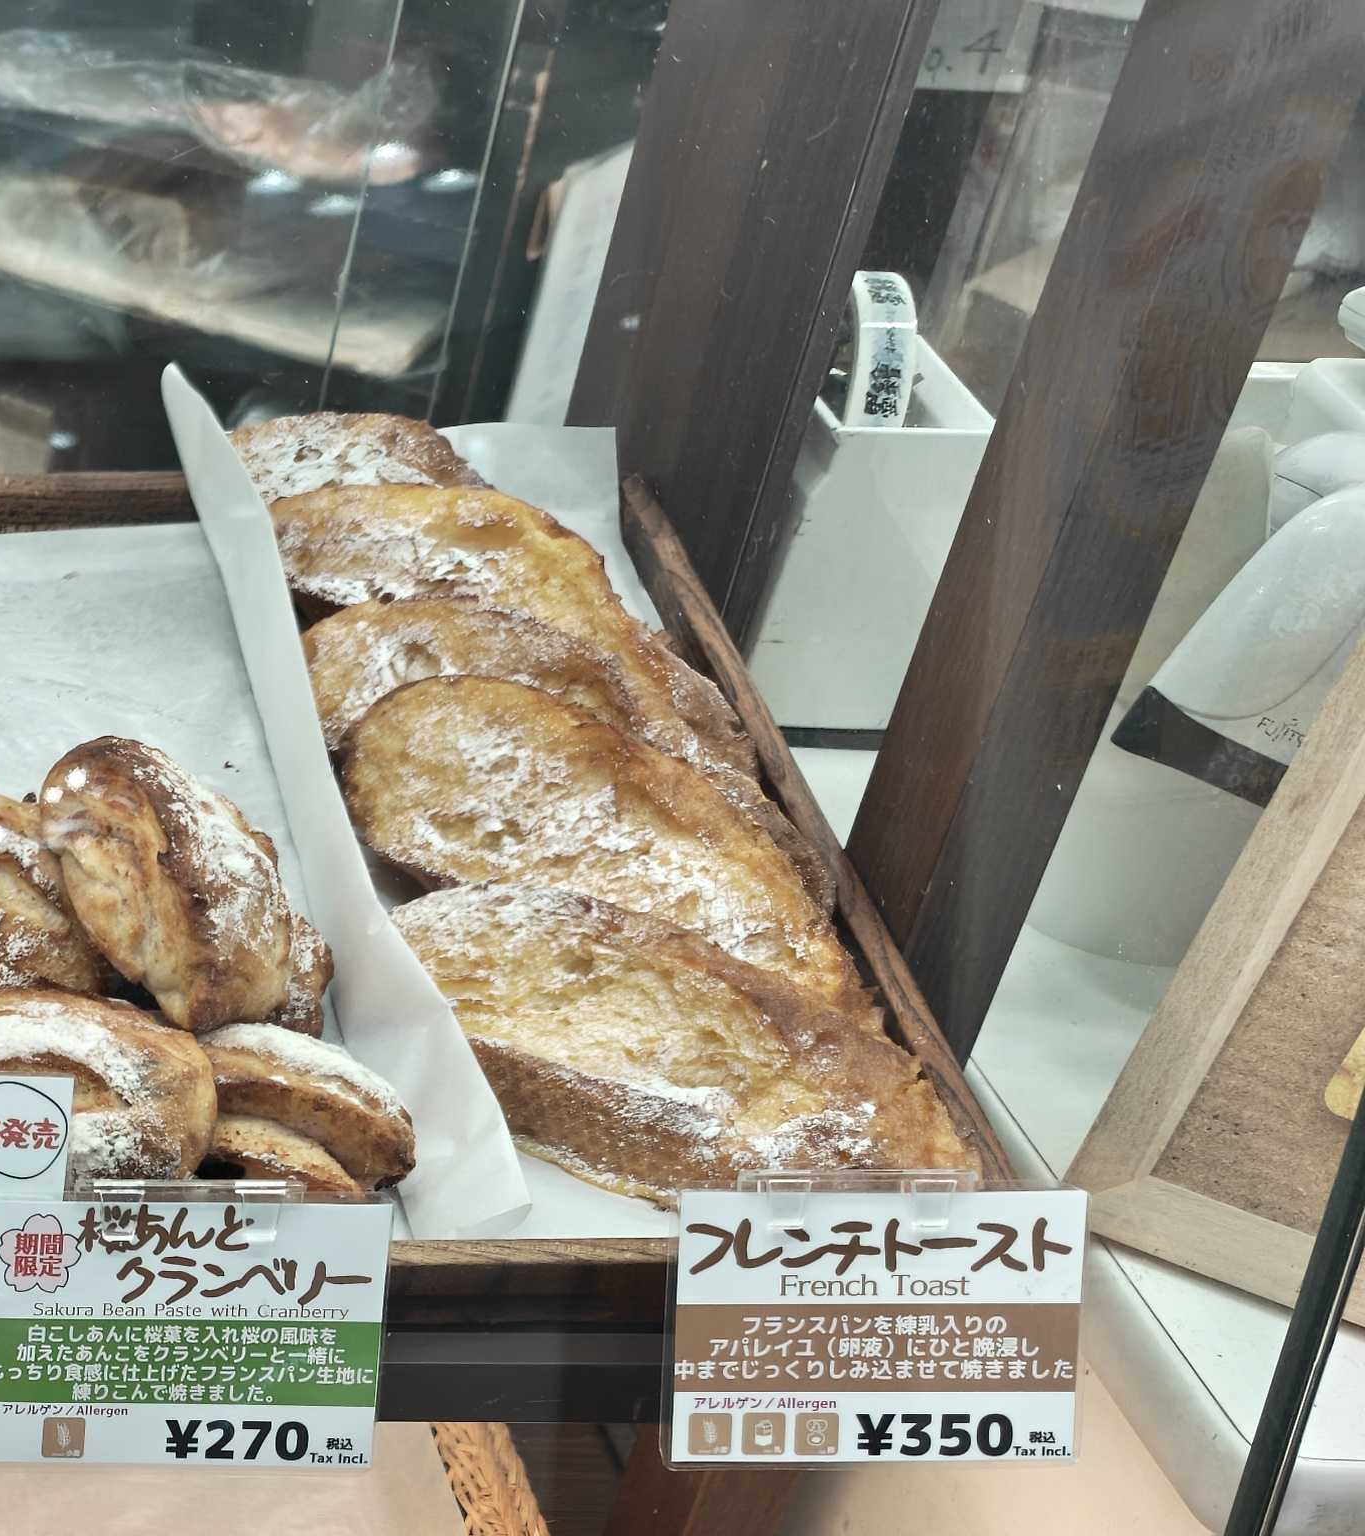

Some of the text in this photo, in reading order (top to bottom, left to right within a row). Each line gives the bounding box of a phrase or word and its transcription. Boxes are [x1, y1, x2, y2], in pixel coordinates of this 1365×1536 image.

[78, 1204, 255, 1255] 桜あんと
[14, 1233, 64, 1256] 期間
[686, 1217, 1073, 1276] フレンチトースト
[14, 1256, 63, 1277] 限定
[116, 1256, 373, 1306] クランベリー
[779, 1274, 970, 1297] French Toast
[34, 1303, 350, 1321] Sakura Bean Paste with Cranberry
[28, 1325, 337, 1346] 白こしあんに桜葉を入れ桜の風味を
[742, 1314, 1007, 1337] フランスパンを練乳入りの
[17, 1344, 346, 1365] 加えたあんこをクランベリーと一緒に
[709, 1337, 1039, 1360] アパレイユ（卵液）にひと晩浸し
[674, 1360, 1074, 1381] 中までじっくりしみ込ませて焼きました
[72, 1383, 274, 1403] 練りこんで焼きました。
[166, 1418, 309, 1462] ¥270
[326, 1437, 353, 1451] 税込
[856, 1413, 1014, 1457] ¥350
[1028, 1431, 1056, 1444] 税込
[310, 1452, 368, 1465] Tax Incl.
[1013, 1445, 1071, 1457] Tax Incl.
